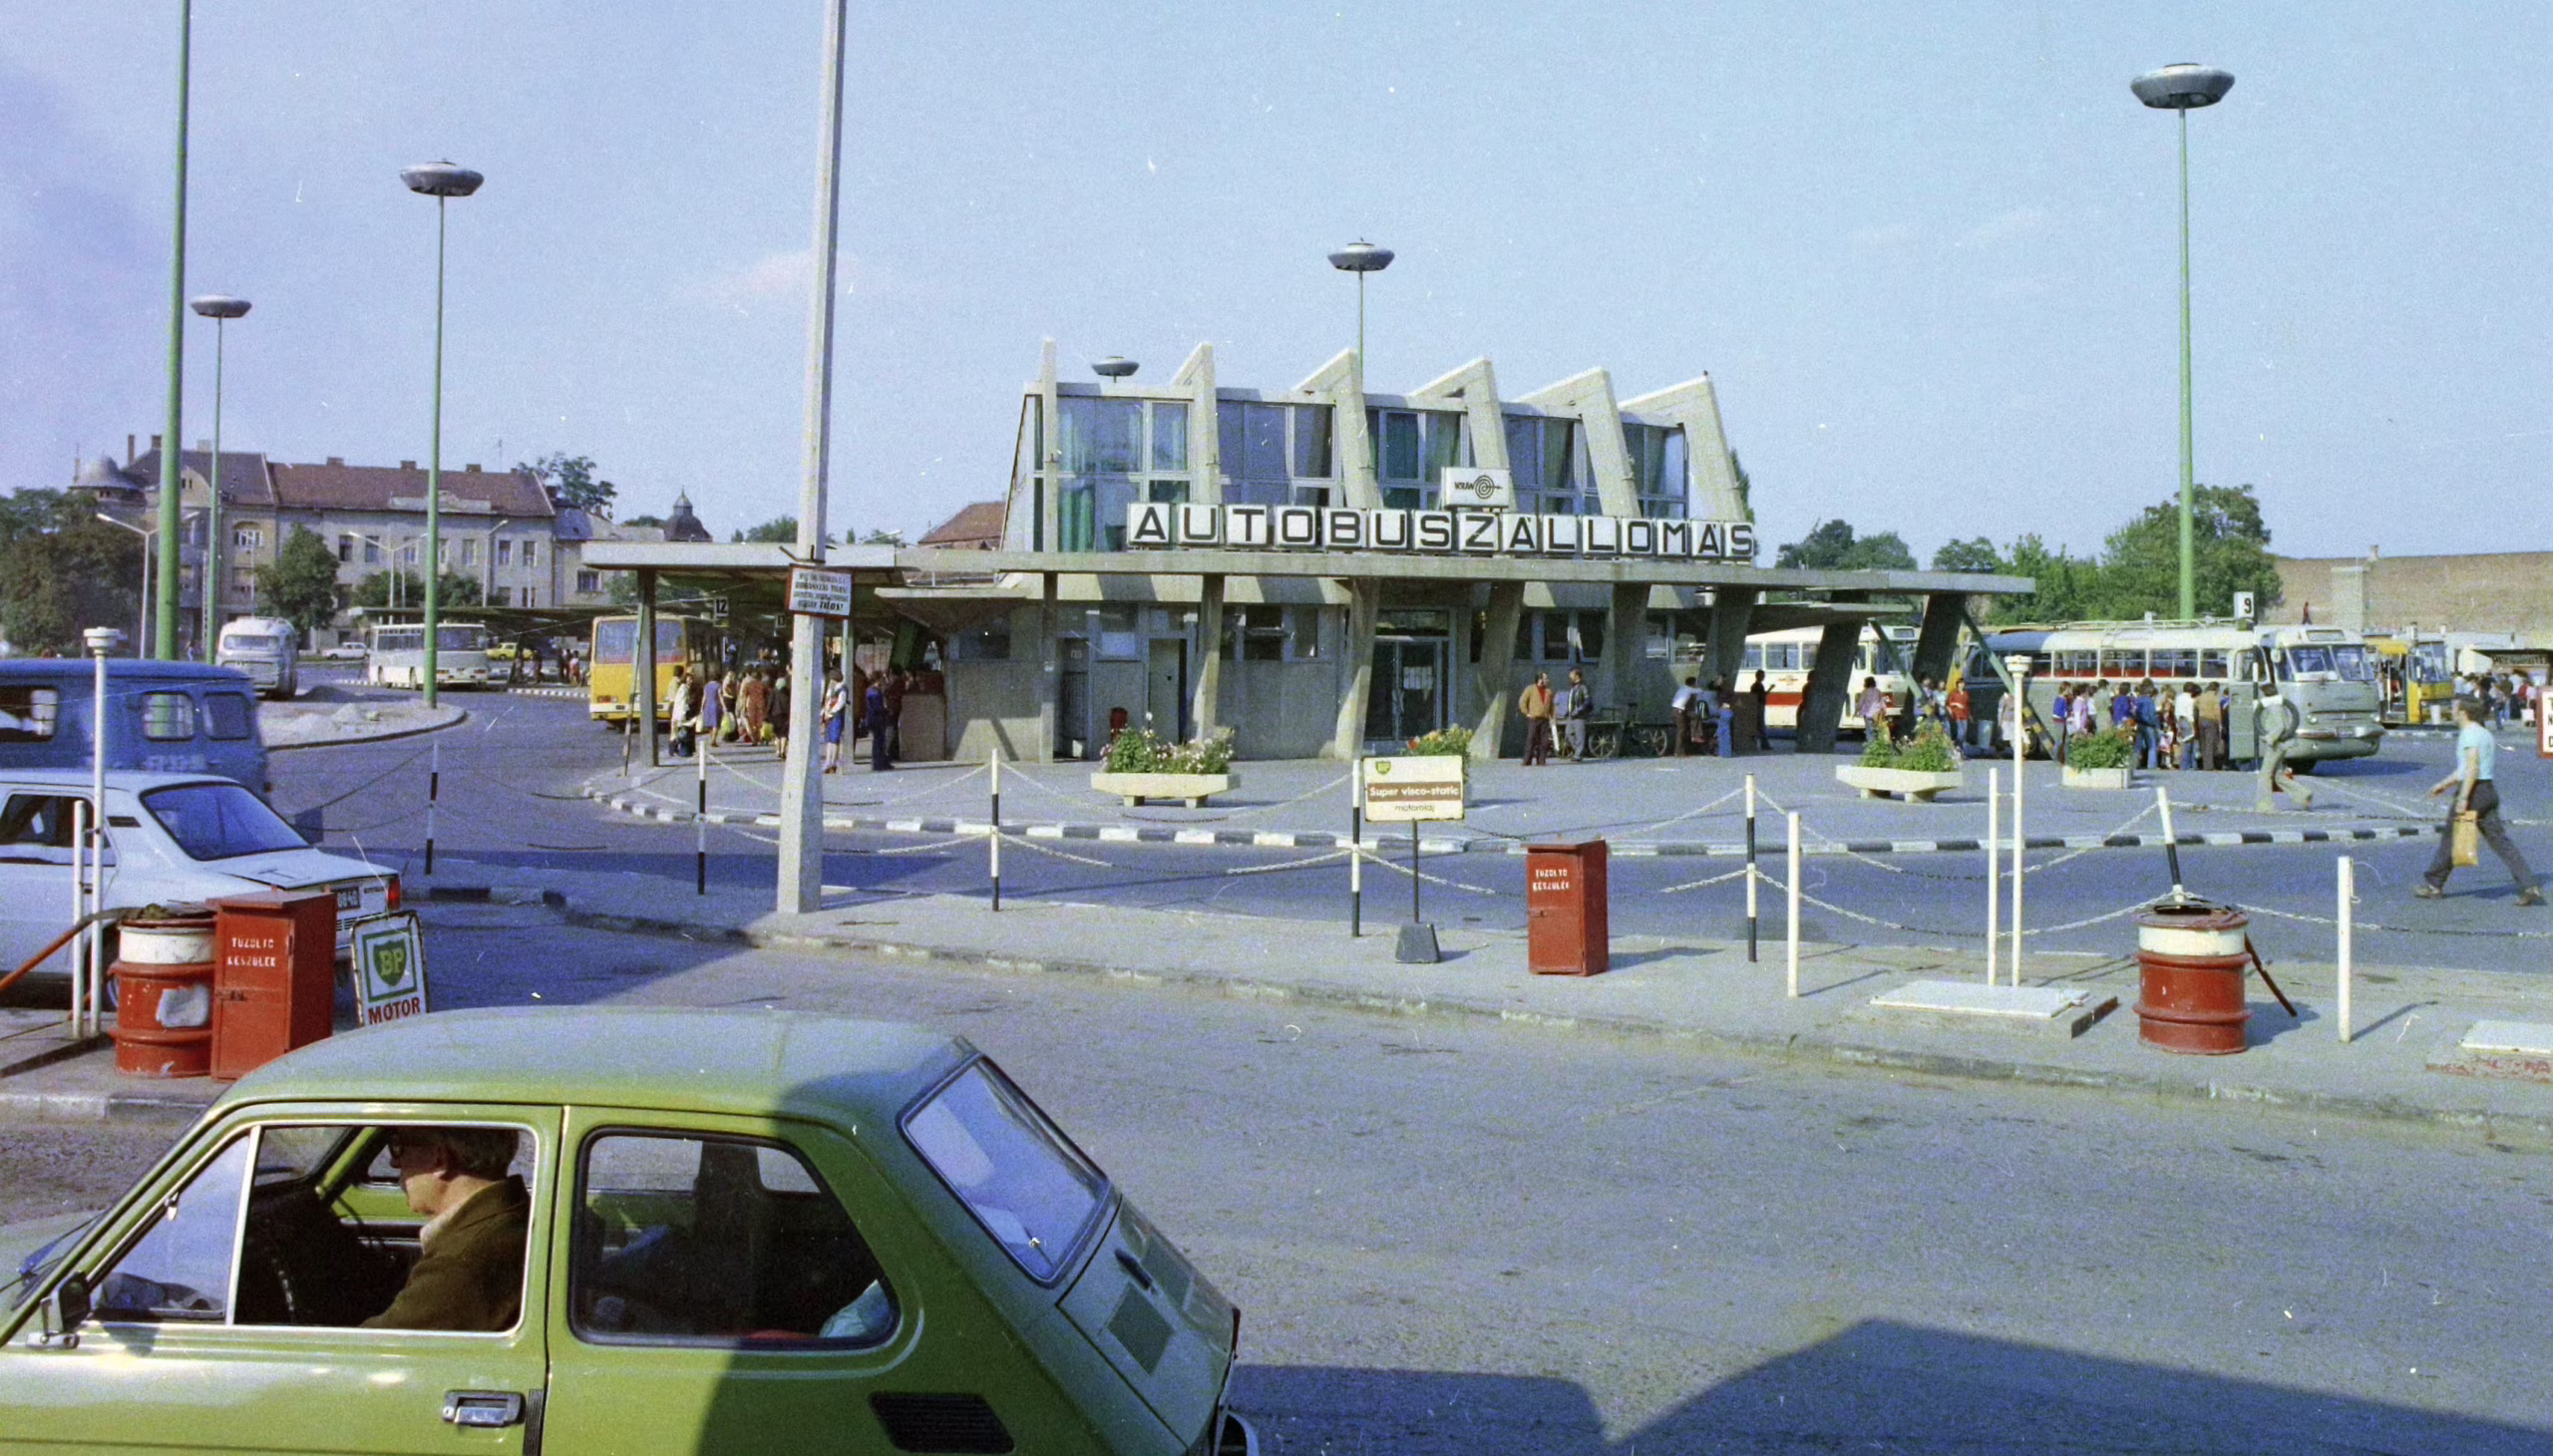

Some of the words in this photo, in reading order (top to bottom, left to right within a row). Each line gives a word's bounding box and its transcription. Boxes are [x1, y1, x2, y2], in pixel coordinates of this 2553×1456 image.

[716, 598, 728, 613] 12
[2244, 597, 2252, 614] 9
[1369, 786, 1398, 798] Super
[1401, 785, 1459, 796] visco-static
[1395, 804, 1434, 813] motorolaj
[379, 946, 404, 976] BP
[368, 997, 421, 1025] MOTOR
